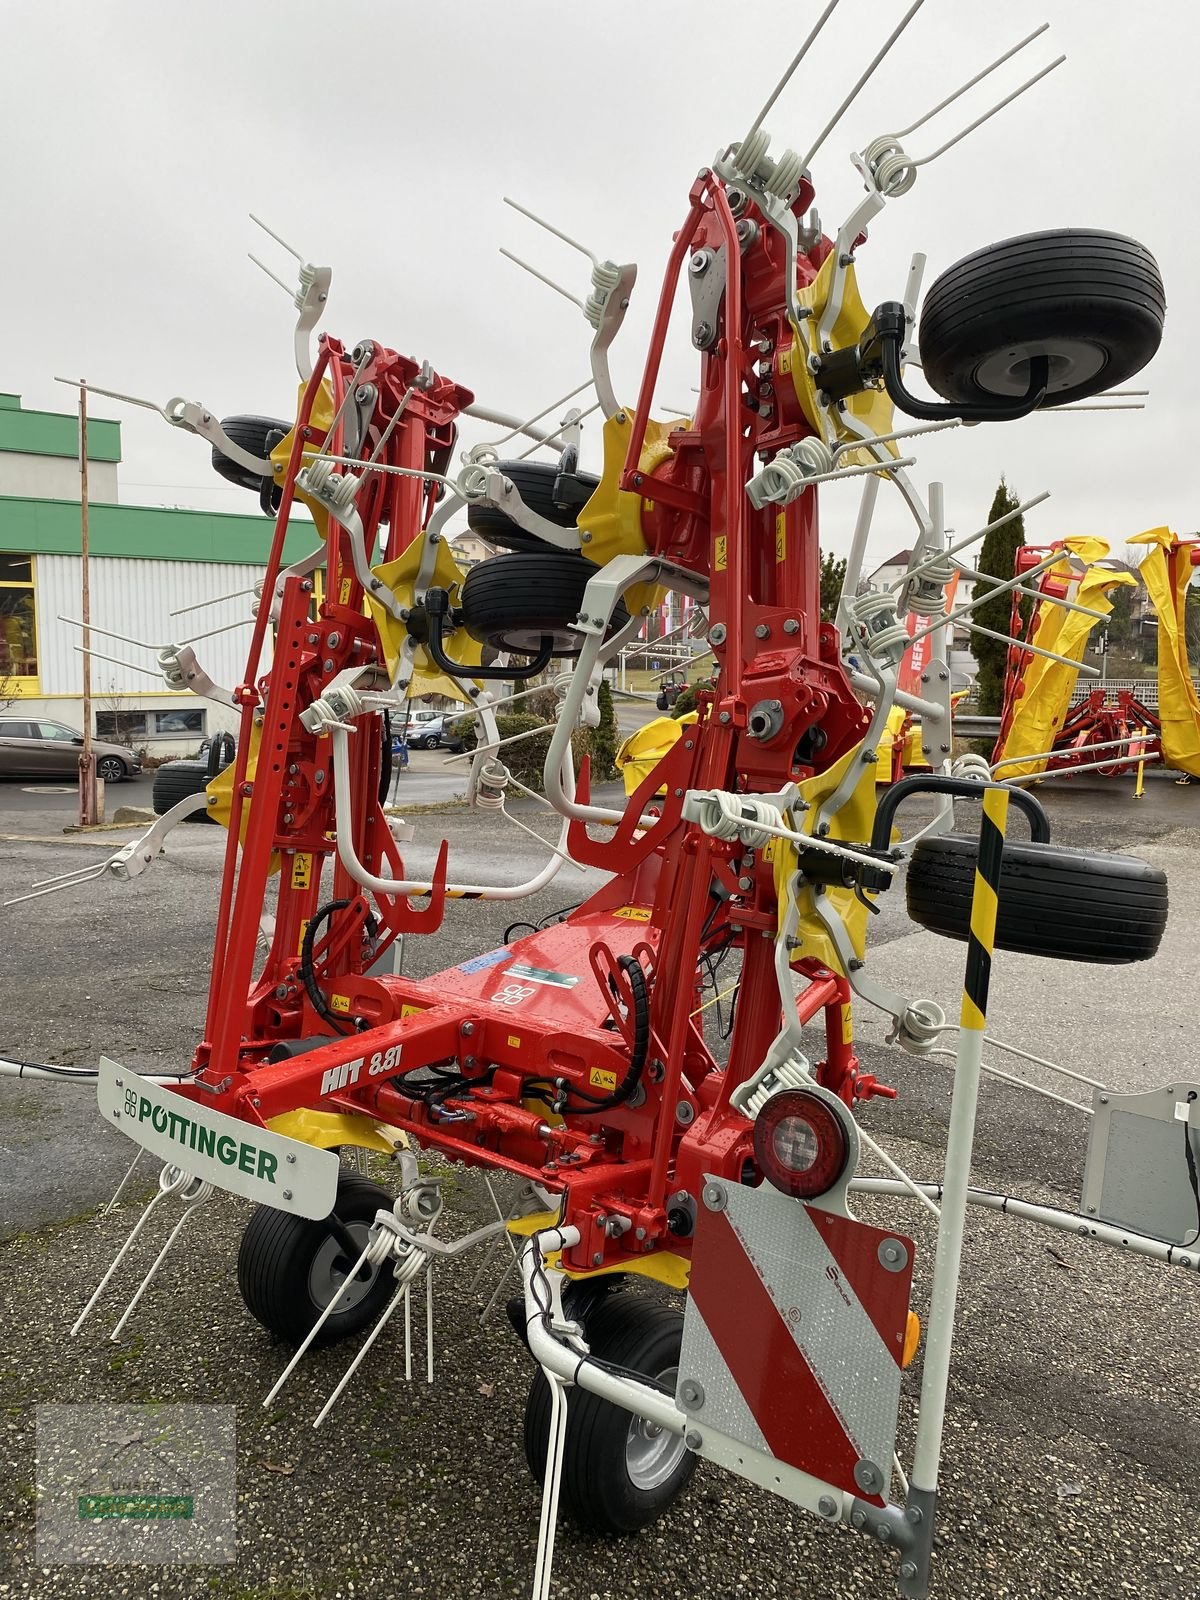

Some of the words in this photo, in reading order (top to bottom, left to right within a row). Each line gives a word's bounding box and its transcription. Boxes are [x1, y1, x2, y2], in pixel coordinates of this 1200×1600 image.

[320, 1057, 365, 1096] HIT
[368, 1043, 403, 1076] 8.81
[138, 1096, 278, 1184] PÖTTINGER
